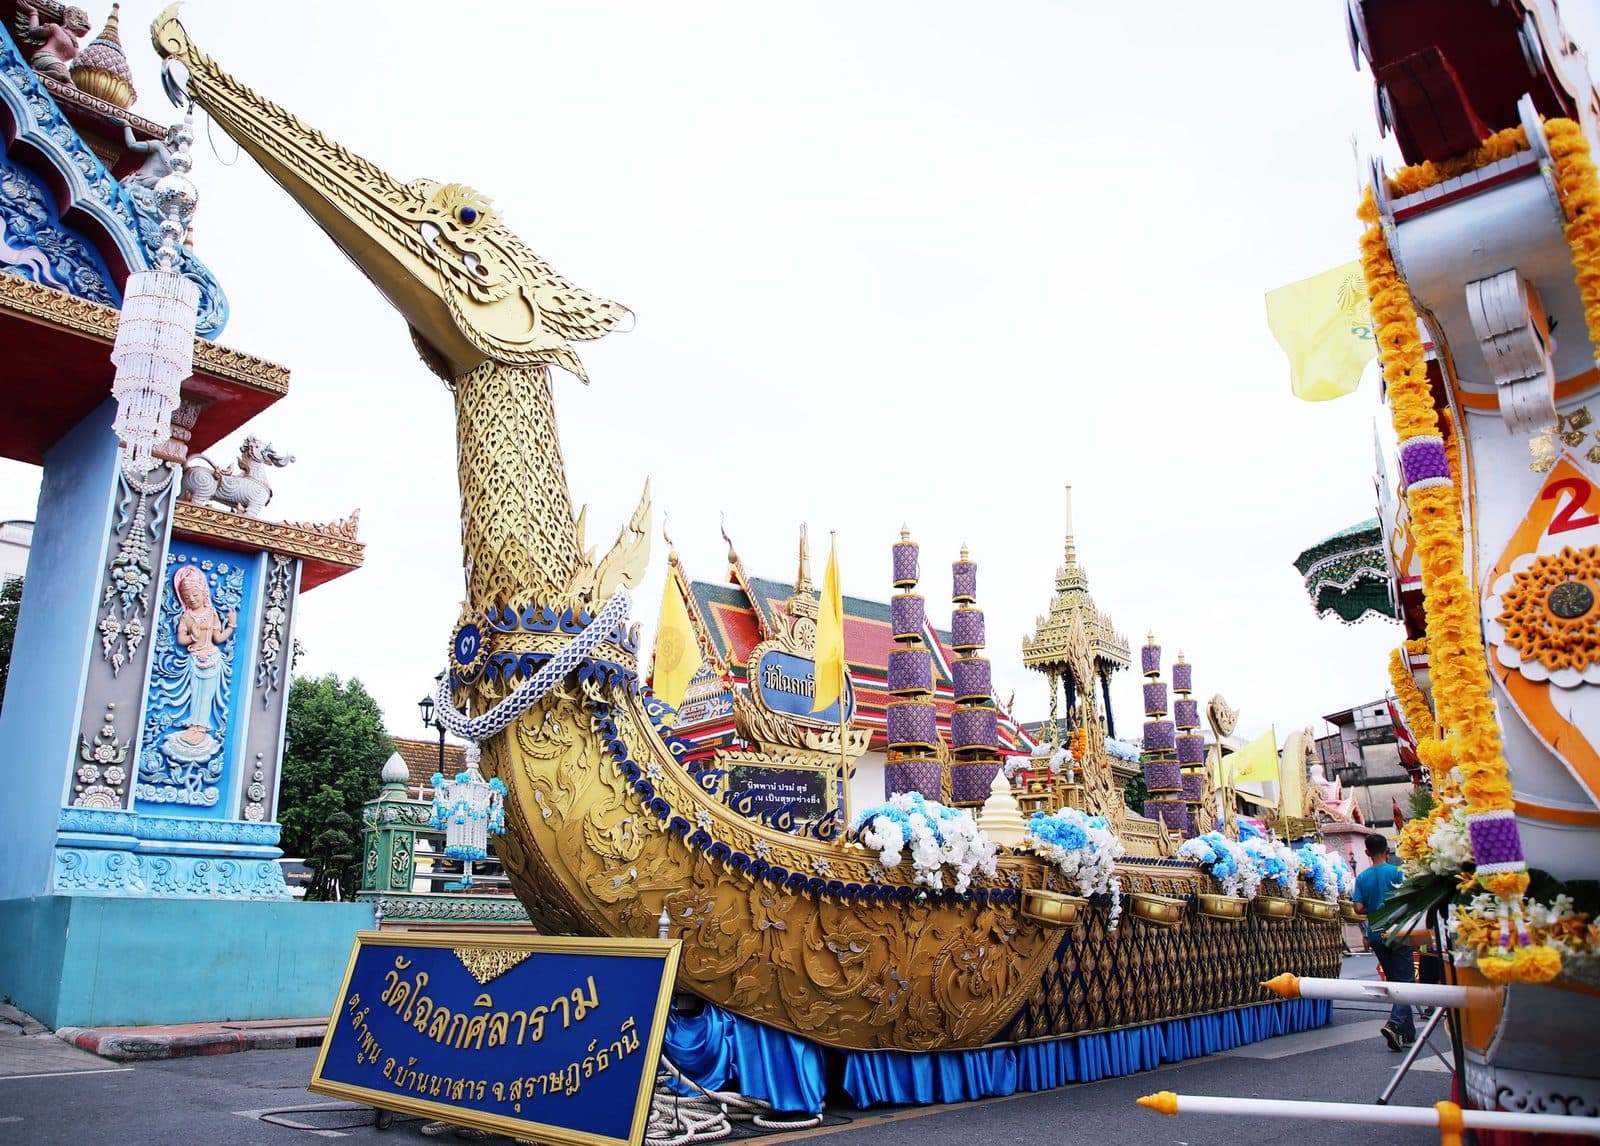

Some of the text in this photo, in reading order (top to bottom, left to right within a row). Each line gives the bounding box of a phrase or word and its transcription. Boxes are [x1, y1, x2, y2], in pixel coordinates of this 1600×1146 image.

[1541, 477, 1599, 536] 2
[460, 635, 475, 656] ๓
[381, 955, 600, 1050] วัดโฉลกศิลาราม
[383, 1056, 488, 1102] อ.บ้านนาสาร
